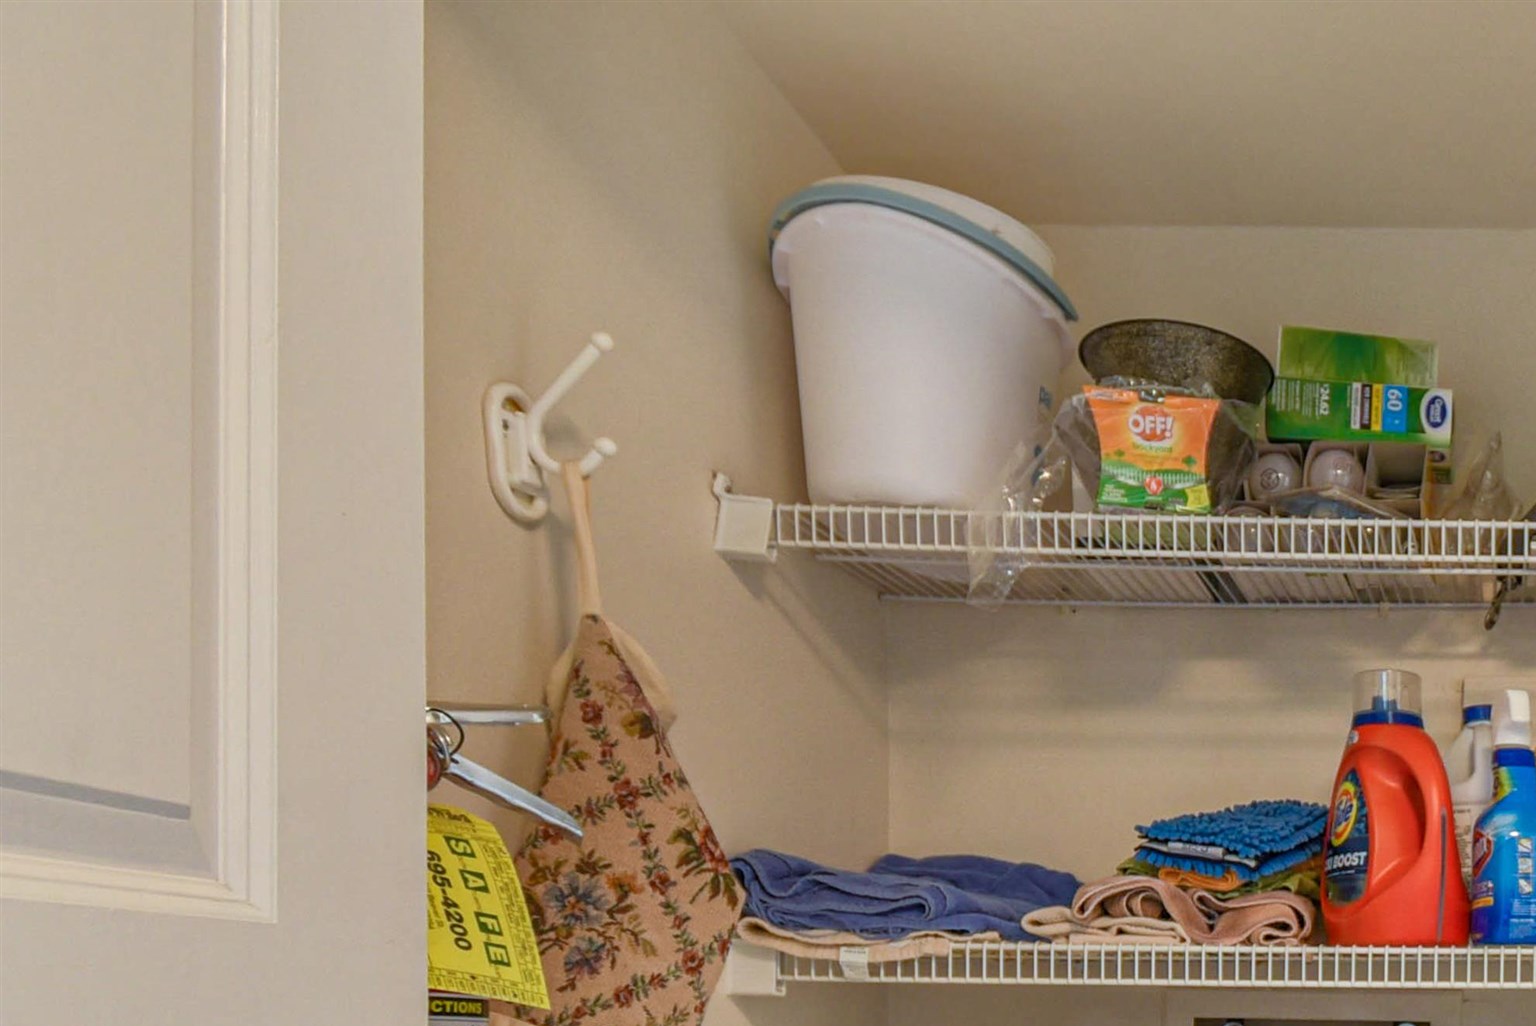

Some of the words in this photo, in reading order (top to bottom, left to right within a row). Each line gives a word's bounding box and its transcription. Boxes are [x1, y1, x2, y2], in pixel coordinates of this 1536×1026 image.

[1387, 388, 1403, 411] 60
[1128, 414, 1174, 438] OFF!
[1333, 851, 1368, 869] BOOST
[429, 1000, 482, 1015] CTIONS
